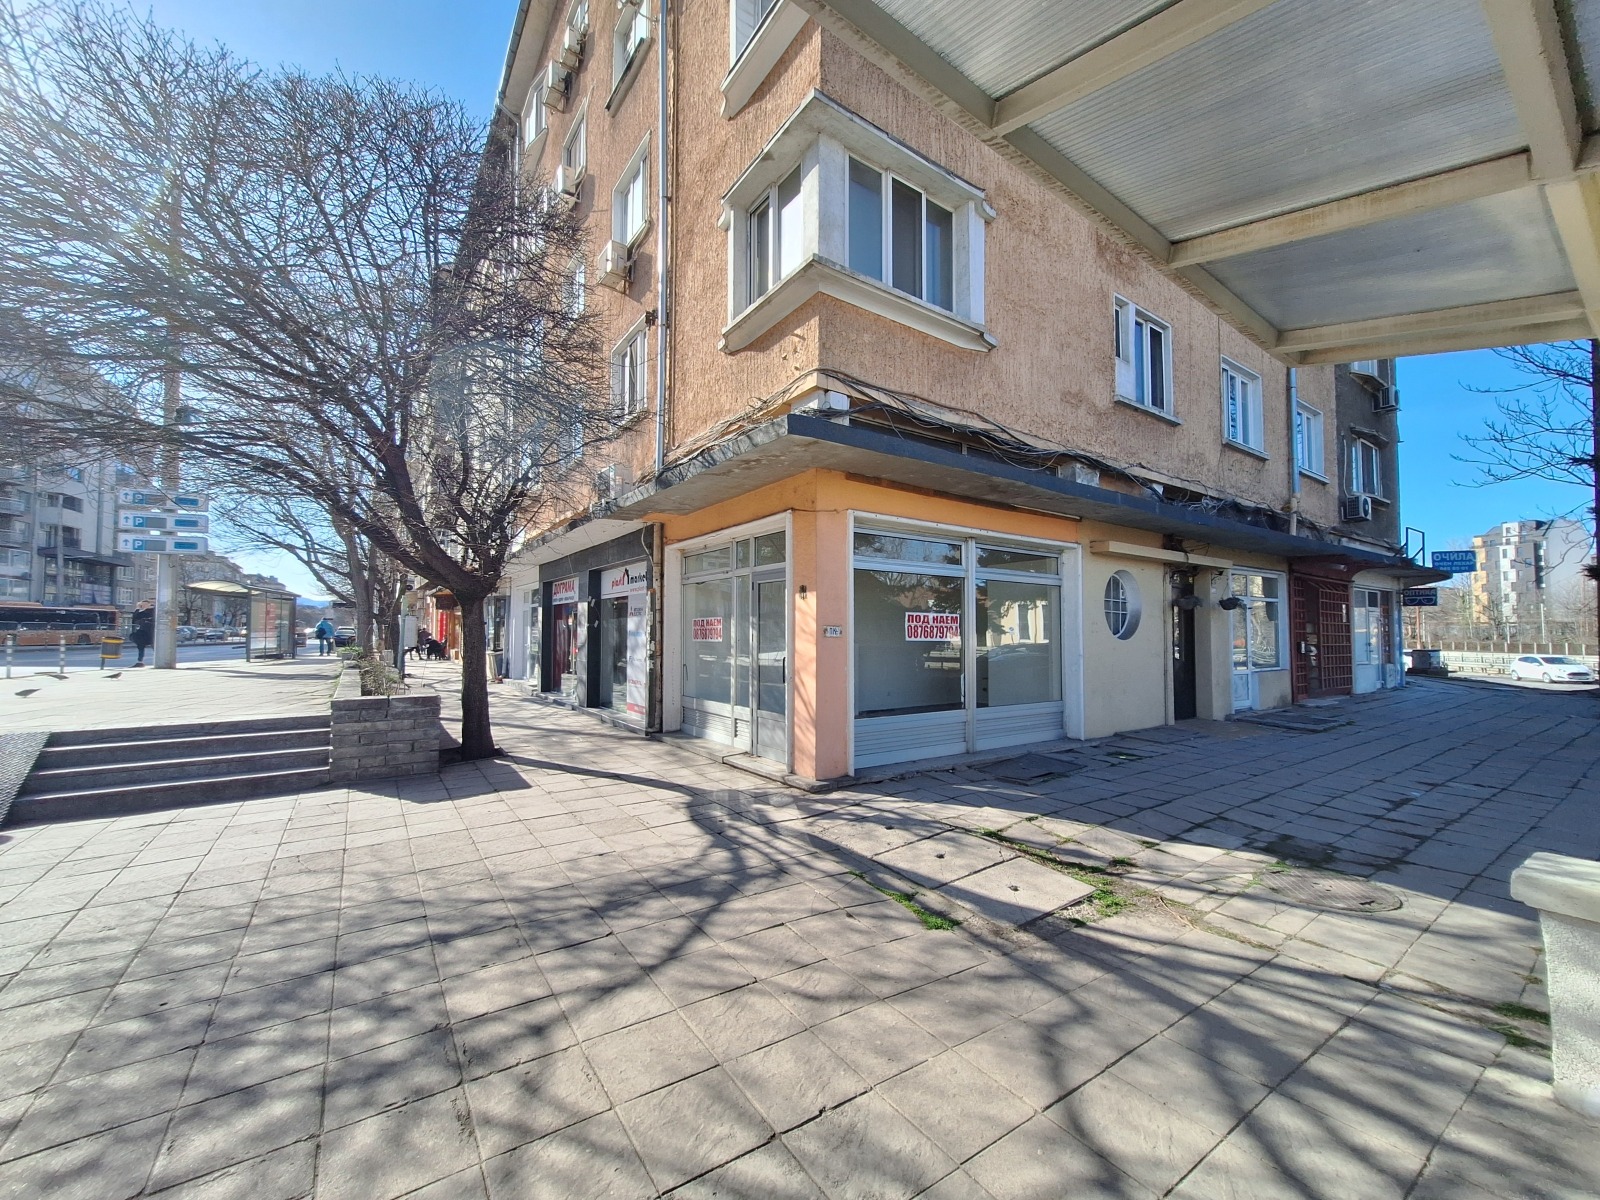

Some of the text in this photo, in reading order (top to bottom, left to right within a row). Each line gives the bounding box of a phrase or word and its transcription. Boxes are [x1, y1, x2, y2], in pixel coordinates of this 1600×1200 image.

[1433, 552, 1474, 561] ОЧИЛА
[554, 580, 575, 597] ДОГРАМА
[693, 618, 722, 628] ПОД НАЕМ
[907, 614, 958, 625] ПОД НАЕМ
[907, 625, 958, 639] 0876879794
